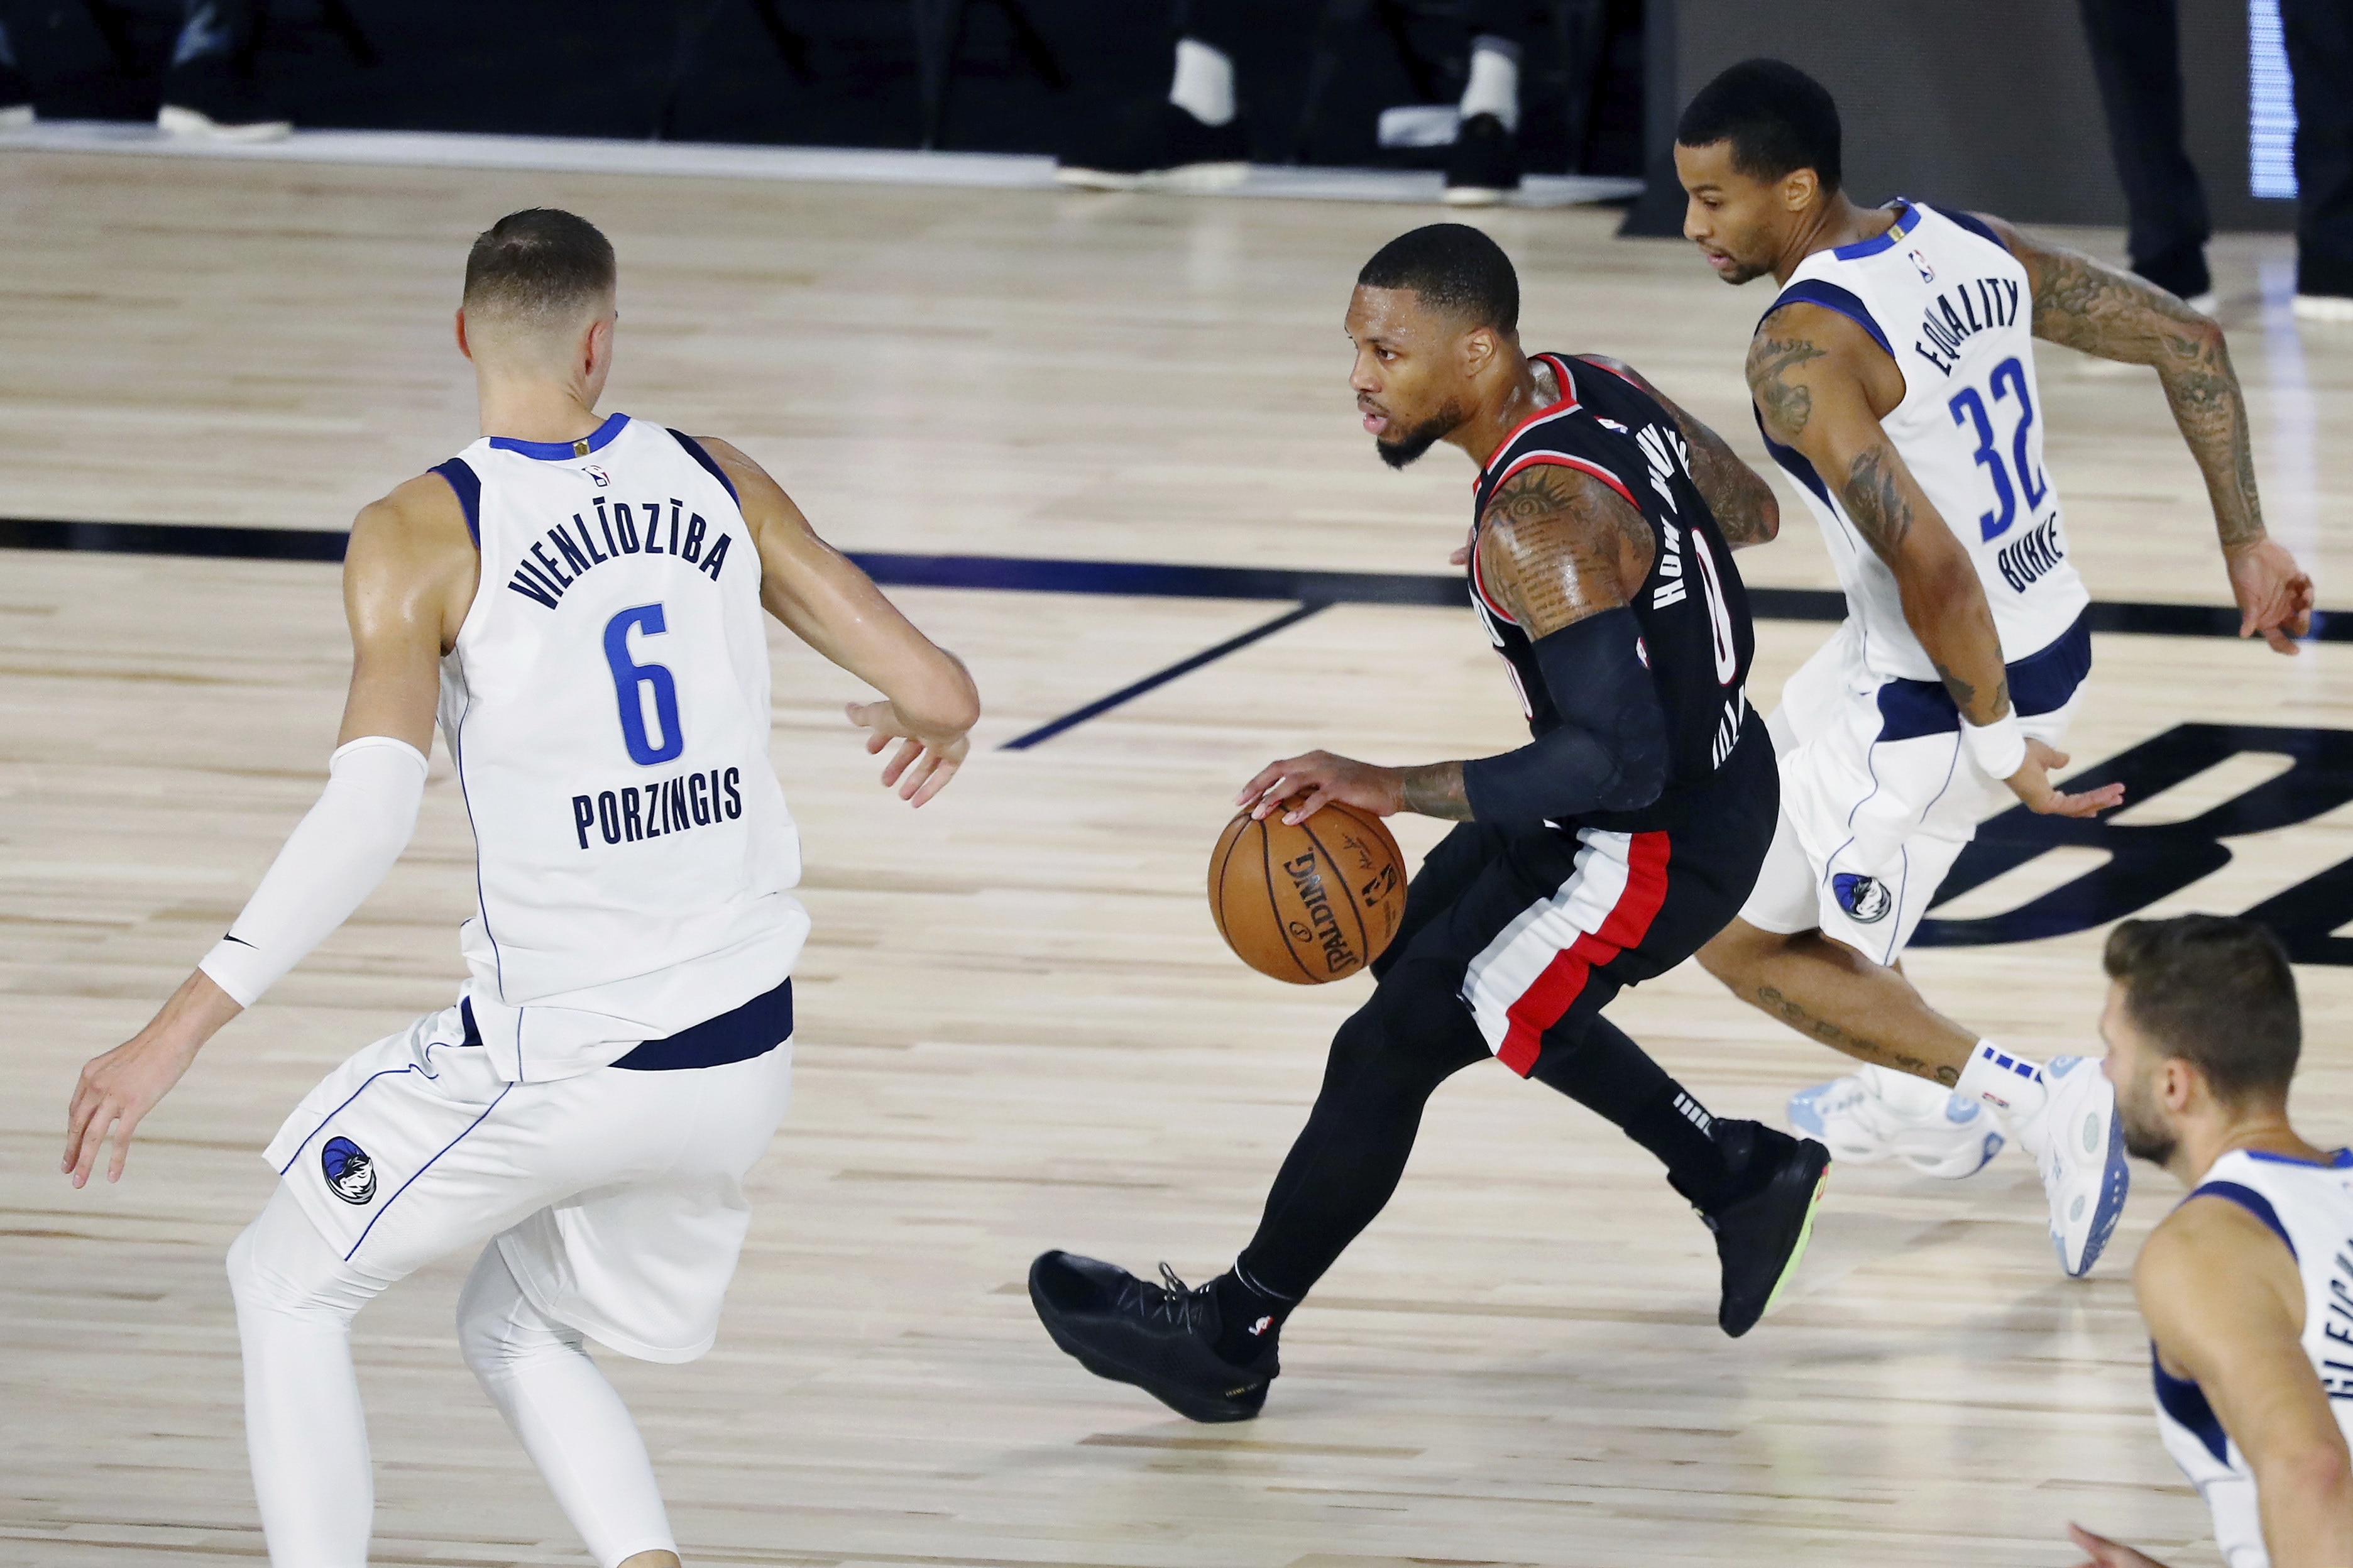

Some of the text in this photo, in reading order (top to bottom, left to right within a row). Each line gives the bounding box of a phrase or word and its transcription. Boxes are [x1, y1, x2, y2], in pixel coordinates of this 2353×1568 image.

[1915, 278, 2019, 377] EQUALITY
[1947, 354, 2048, 544] 32
[507, 496, 733, 610] VIENLĪDZĪBA
[1998, 511, 2065, 594] BURKE
[602, 601, 685, 767] 6
[573, 767, 743, 850] PORZINGIS
[1284, 851, 1359, 973] SPALDING
